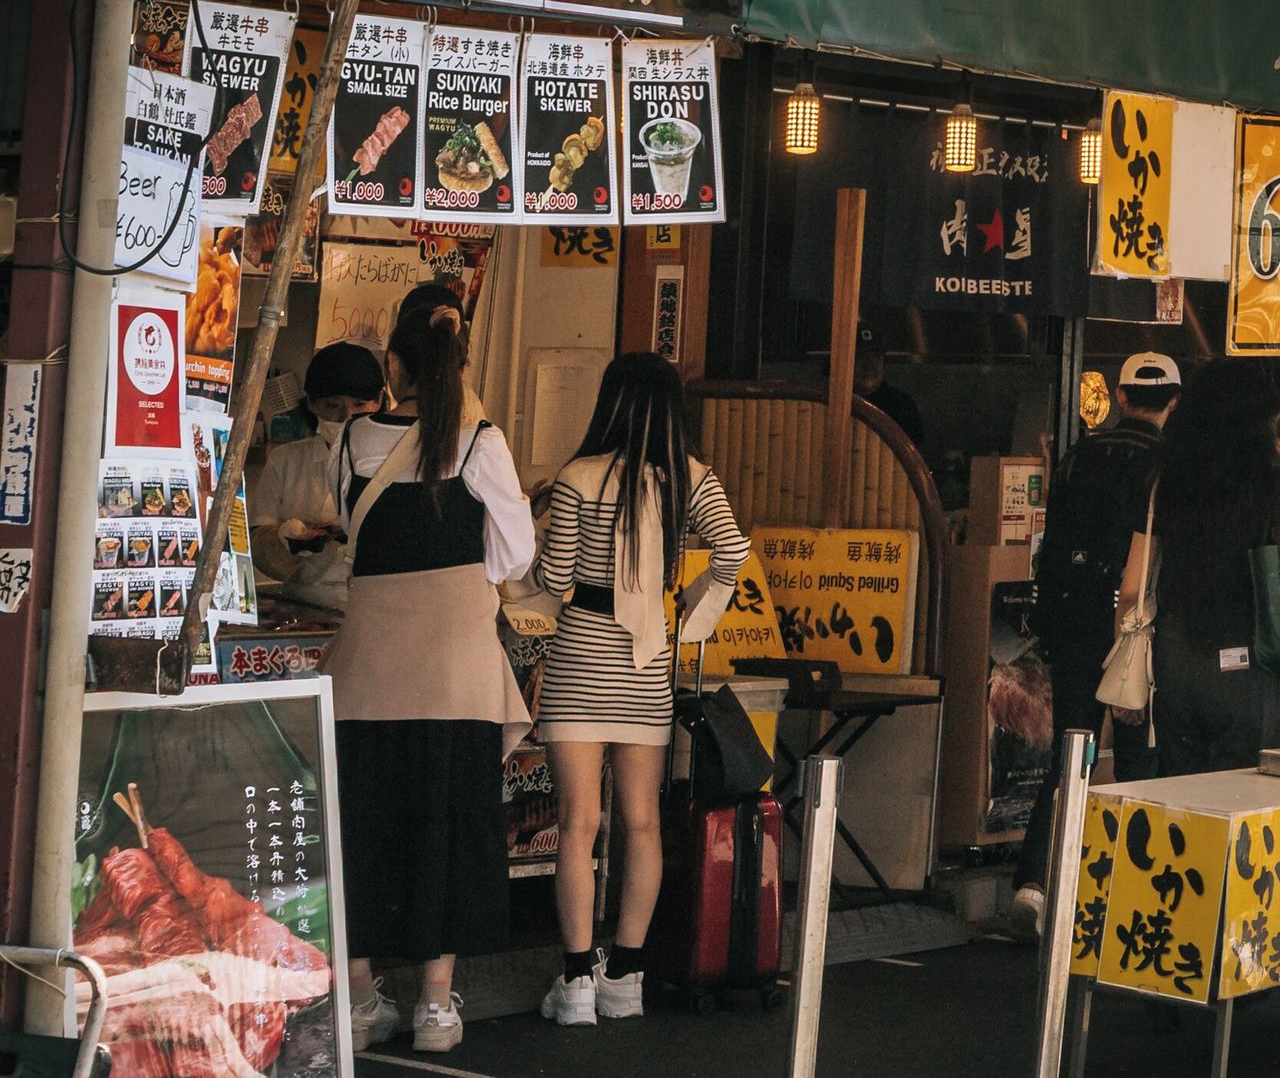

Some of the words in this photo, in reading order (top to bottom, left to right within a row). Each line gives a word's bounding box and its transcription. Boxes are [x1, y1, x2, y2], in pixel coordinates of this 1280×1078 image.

[210, 12, 269, 37] 厳選牛串
[353, 23, 408, 45] 厳選牛串
[218, 33, 255, 51] 牛モモ
[348, 43, 383, 58] 牛タン
[432, 34, 512, 57] 特選すき焼き
[431, 53, 510, 72] ライスバーガー
[548, 43, 584, 65] 海鮮串
[646, 48, 684, 66] 海鮮丼
[201, 52, 267, 76] WAGYU
[340, 61, 416, 86] GYU-TAN
[527, 61, 569, 77] 北海道産
[573, 64, 606, 78] ホタテ
[628, 66, 647, 79] 関西
[651, 67, 710, 81] 生シラス丼
[347, 82, 383, 97] SMALL
[384, 84, 408, 98] SIZE
[436, 73, 502, 94] SUKIYAKI
[534, 80, 598, 99] HOTATE
[154, 83, 187, 106] 日本酒
[633, 85, 704, 102] SHIRASU
[428, 92, 460, 110] Rice
[463, 94, 509, 117] Burger
[540, 98, 592, 113] SKEWER
[647, 101, 689, 119] DON
[429, 117, 457, 125] PREMIUM
[429, 124, 456, 132] WAGYU
[147, 125, 183, 148] SAKE
[119, 161, 162, 200] Beer
[1110, 98, 1164, 271] いか焼き
[335, 180, 384, 201] ¥1,000
[425, 188, 479, 207] ¥2,000
[525, 192, 577, 210] ¥1,000
[632, 193, 682, 210] ¥1,500
[333, 298, 389, 340] 5000
[818, 576, 854, 592] Squid
[858, 577, 899, 593] Grilled
[1116, 808, 1203, 994] いか焼き
